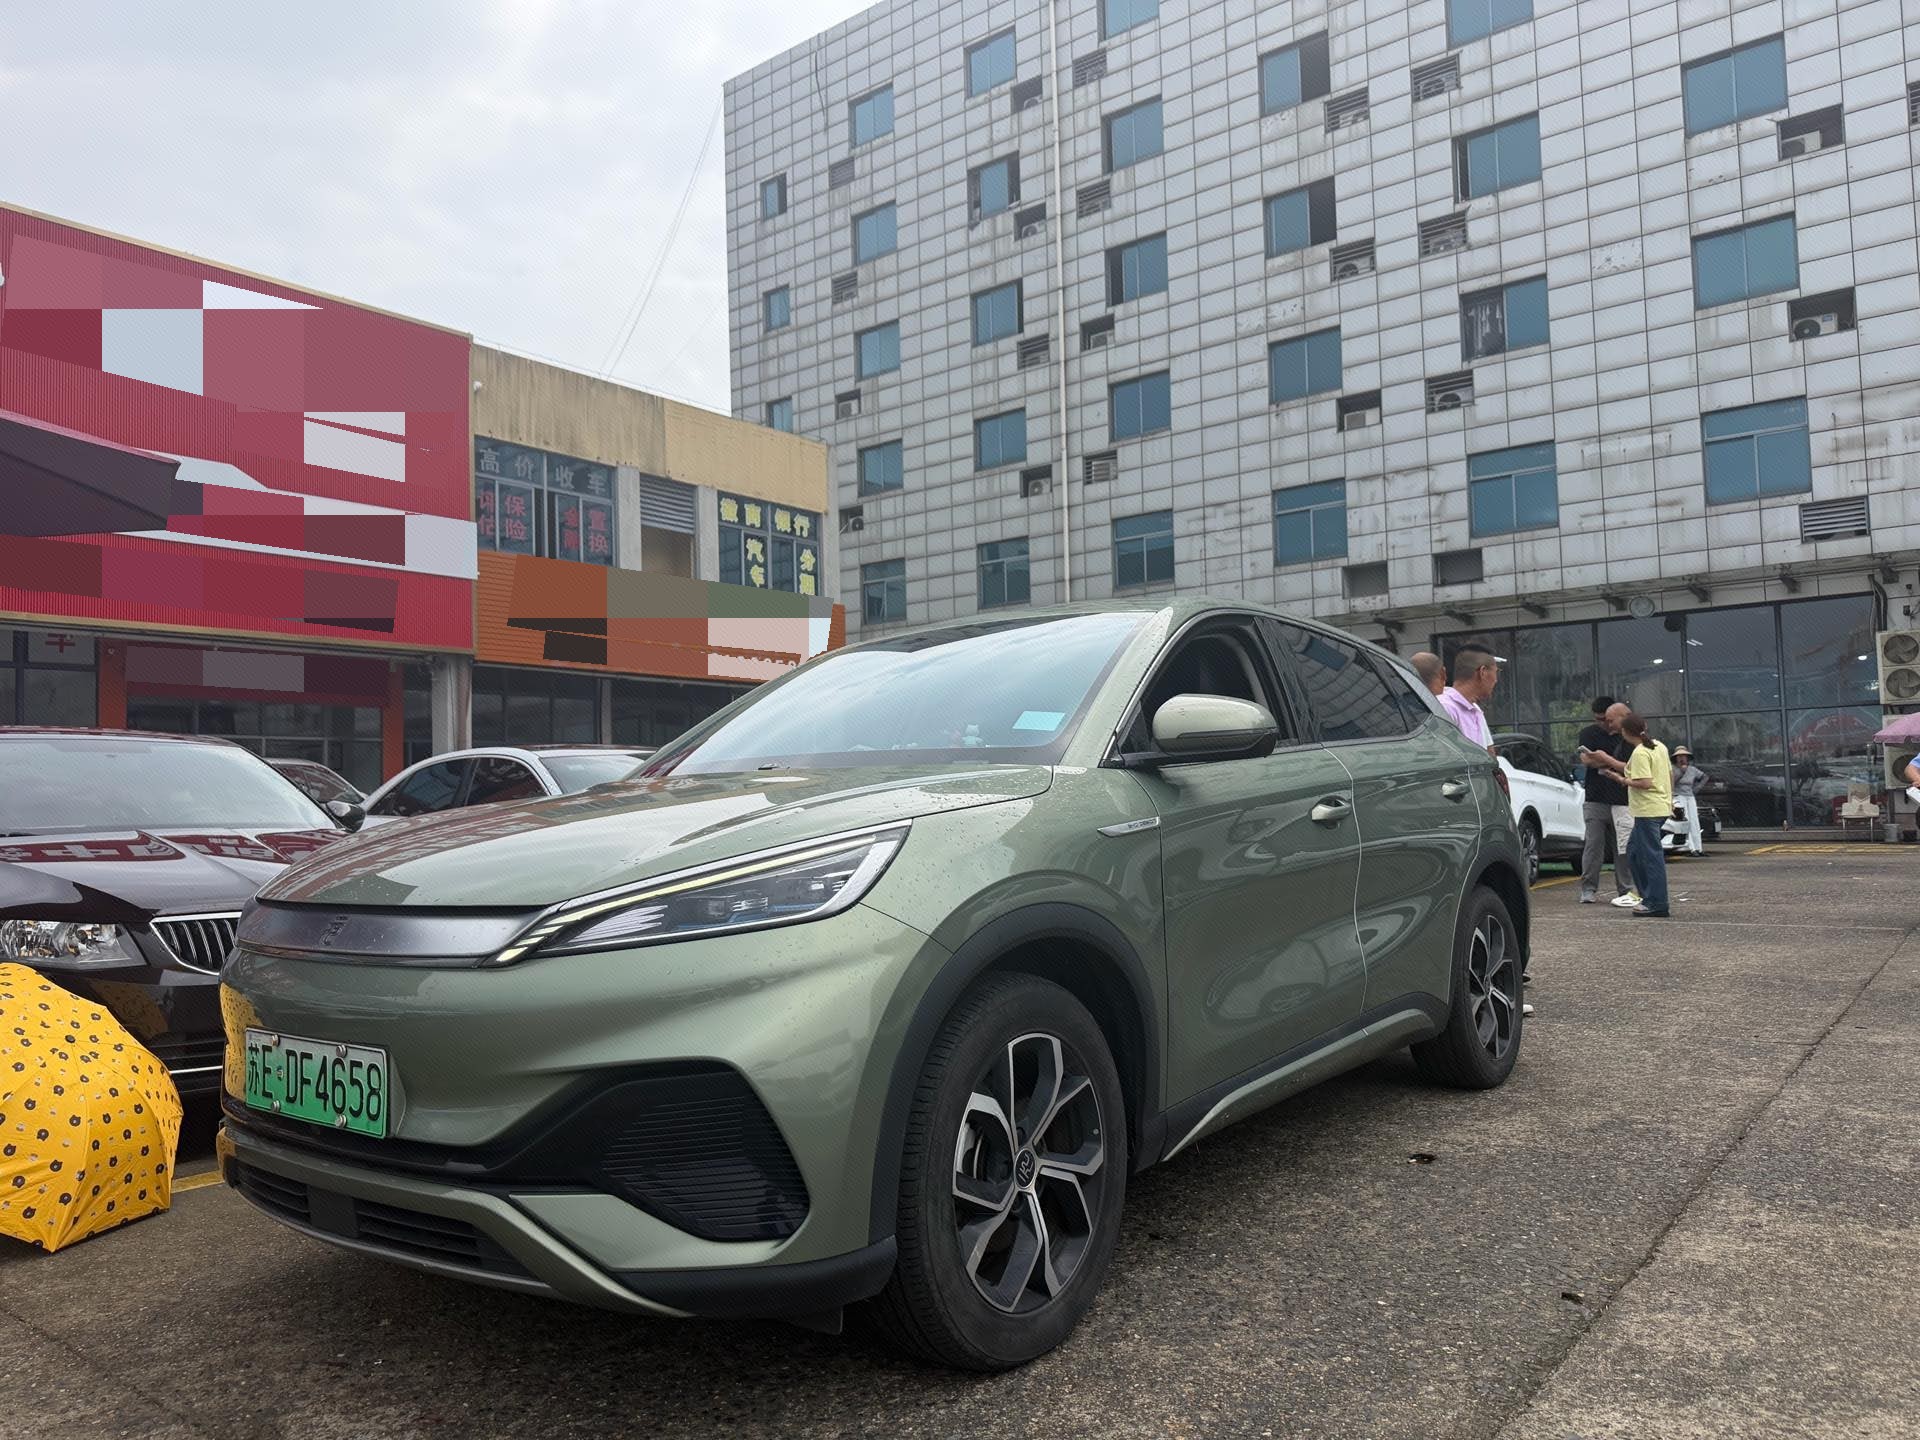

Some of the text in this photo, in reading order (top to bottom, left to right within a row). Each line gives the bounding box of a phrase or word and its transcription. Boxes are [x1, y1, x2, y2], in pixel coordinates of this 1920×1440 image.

[480, 448, 606, 494] 高价收车
[505, 495, 527, 540] 保险
[746, 538, 765, 587] 汽车
[799, 549, 815, 595] 分期
